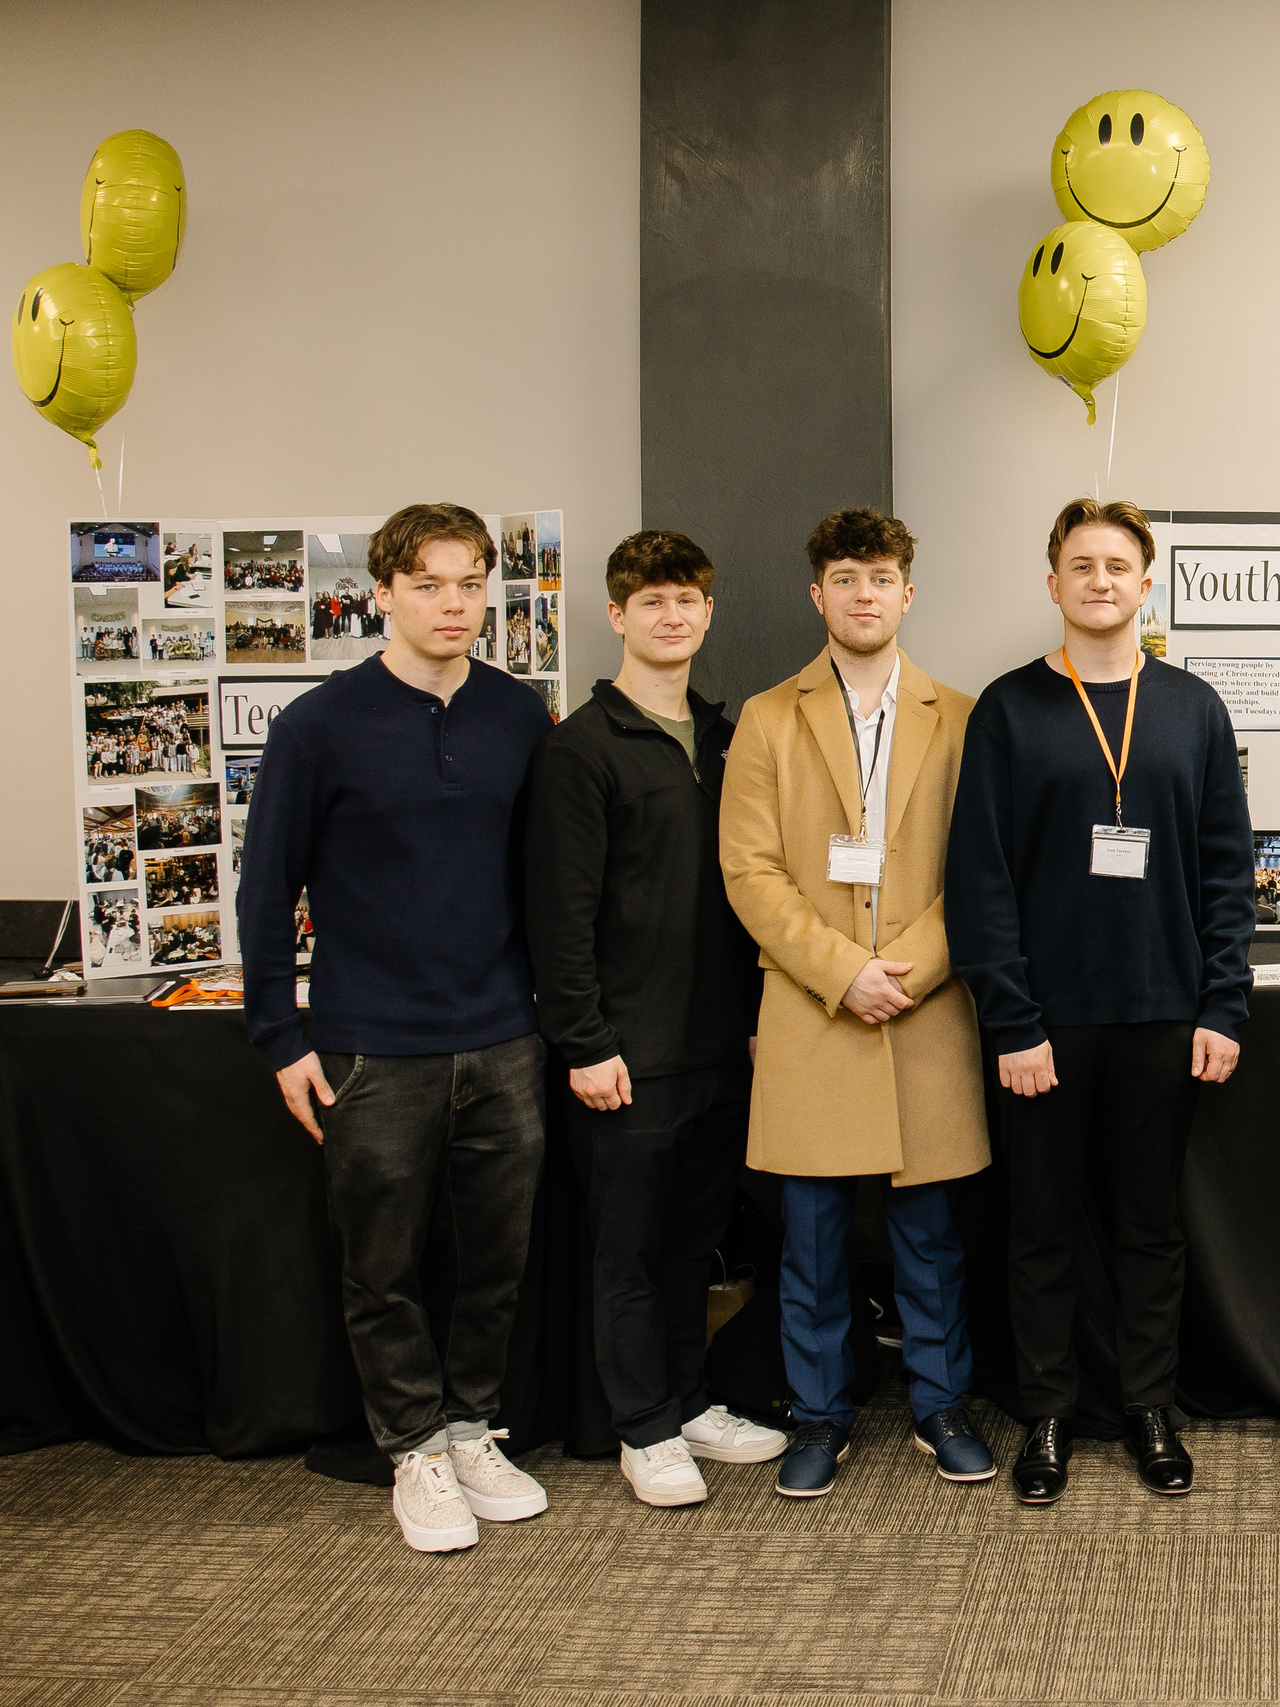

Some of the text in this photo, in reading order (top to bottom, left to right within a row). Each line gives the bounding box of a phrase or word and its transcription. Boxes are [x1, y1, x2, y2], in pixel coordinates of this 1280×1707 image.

[1189, 660, 1274, 670] Serving young people by
[1225, 670, 1280, 678] Christ-centered
[1253, 680, 1268, 688] they
[1244, 708, 1277, 716] Tuesdays
